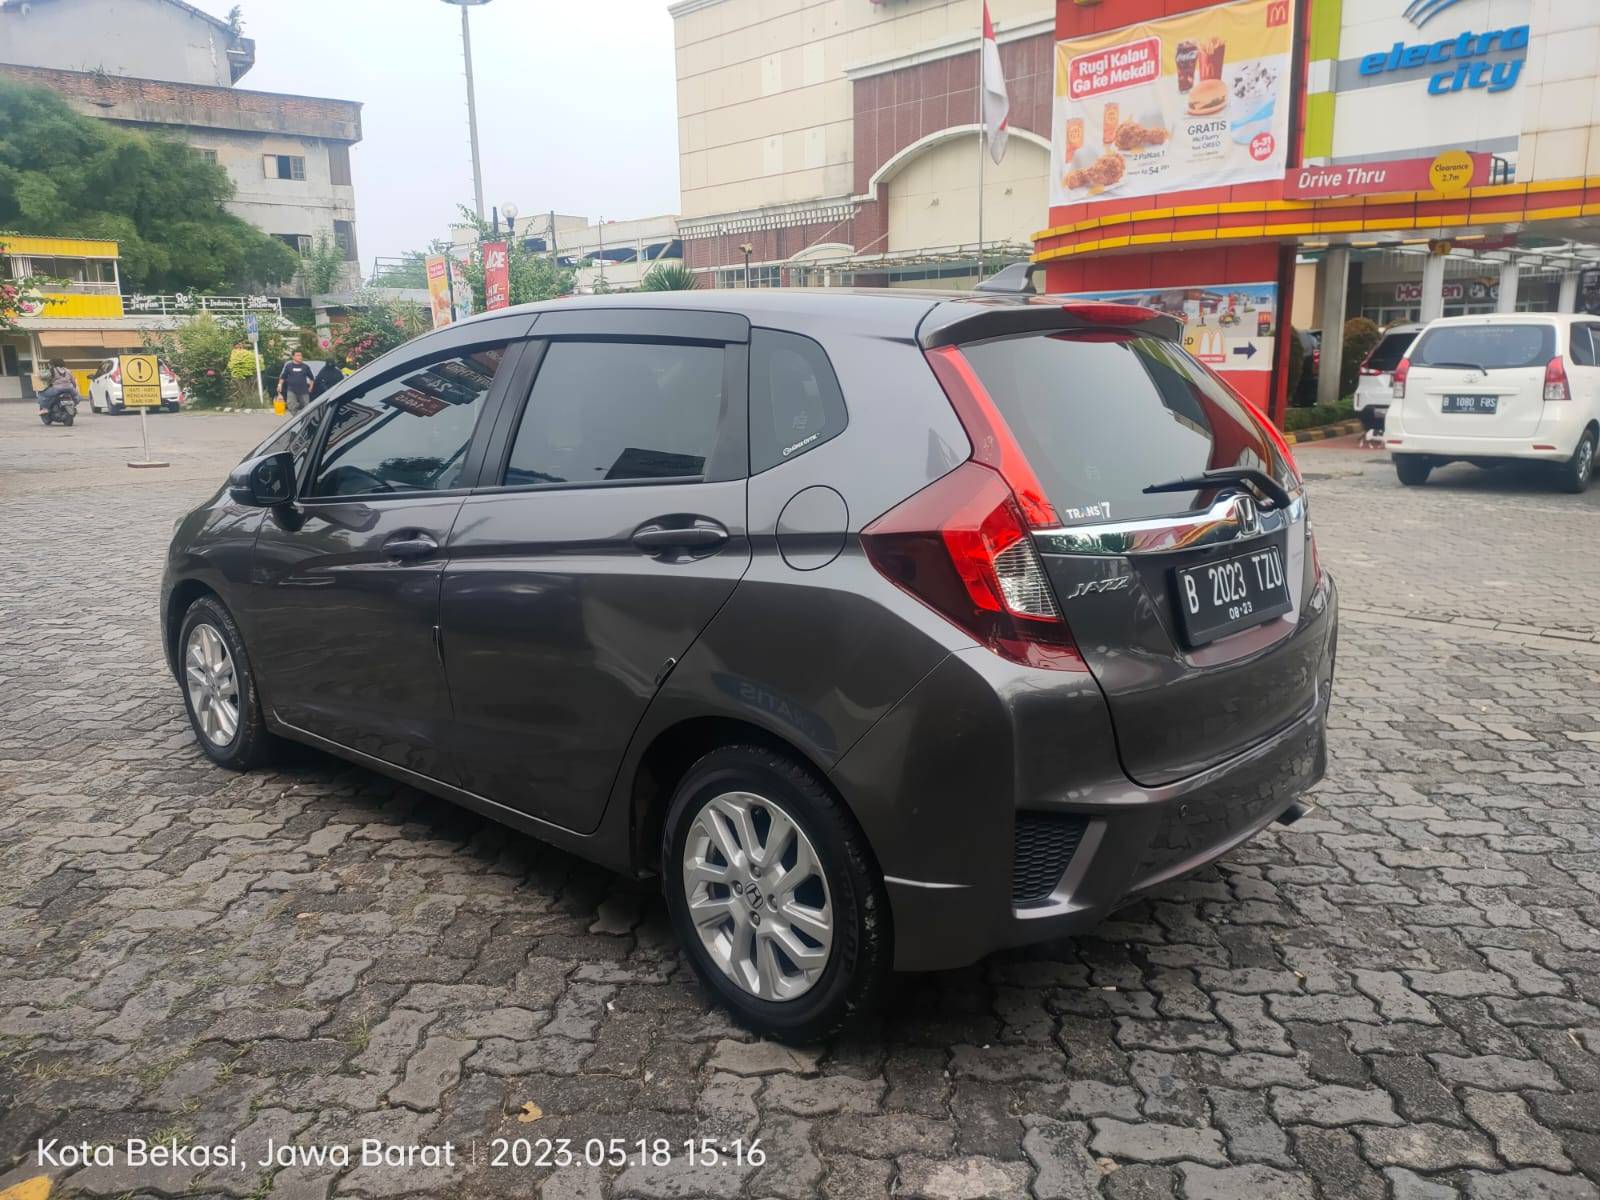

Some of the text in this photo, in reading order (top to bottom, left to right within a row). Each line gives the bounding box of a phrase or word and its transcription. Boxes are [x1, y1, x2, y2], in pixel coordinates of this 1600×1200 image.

[1078, 54, 1109, 76] Rugi
[1110, 48, 1149, 68] Kalau
[1072, 78, 1091, 93] Ga
[1427, 58, 1525, 96] city
[1187, 120, 1227, 136] GRATIS
[1148, 166, 1159, 175] 54
[1434, 163, 1469, 172] Clearance
[1297, 168, 1386, 189] Drive Thru
[1441, 174, 1460, 182] 2.7m
[485, 249, 506, 269] ACE
[1396, 283, 1463, 301] Hoen
[1067, 575, 1130, 599] JAZZ
[1183, 550, 1283, 615] B 2023 TZU
